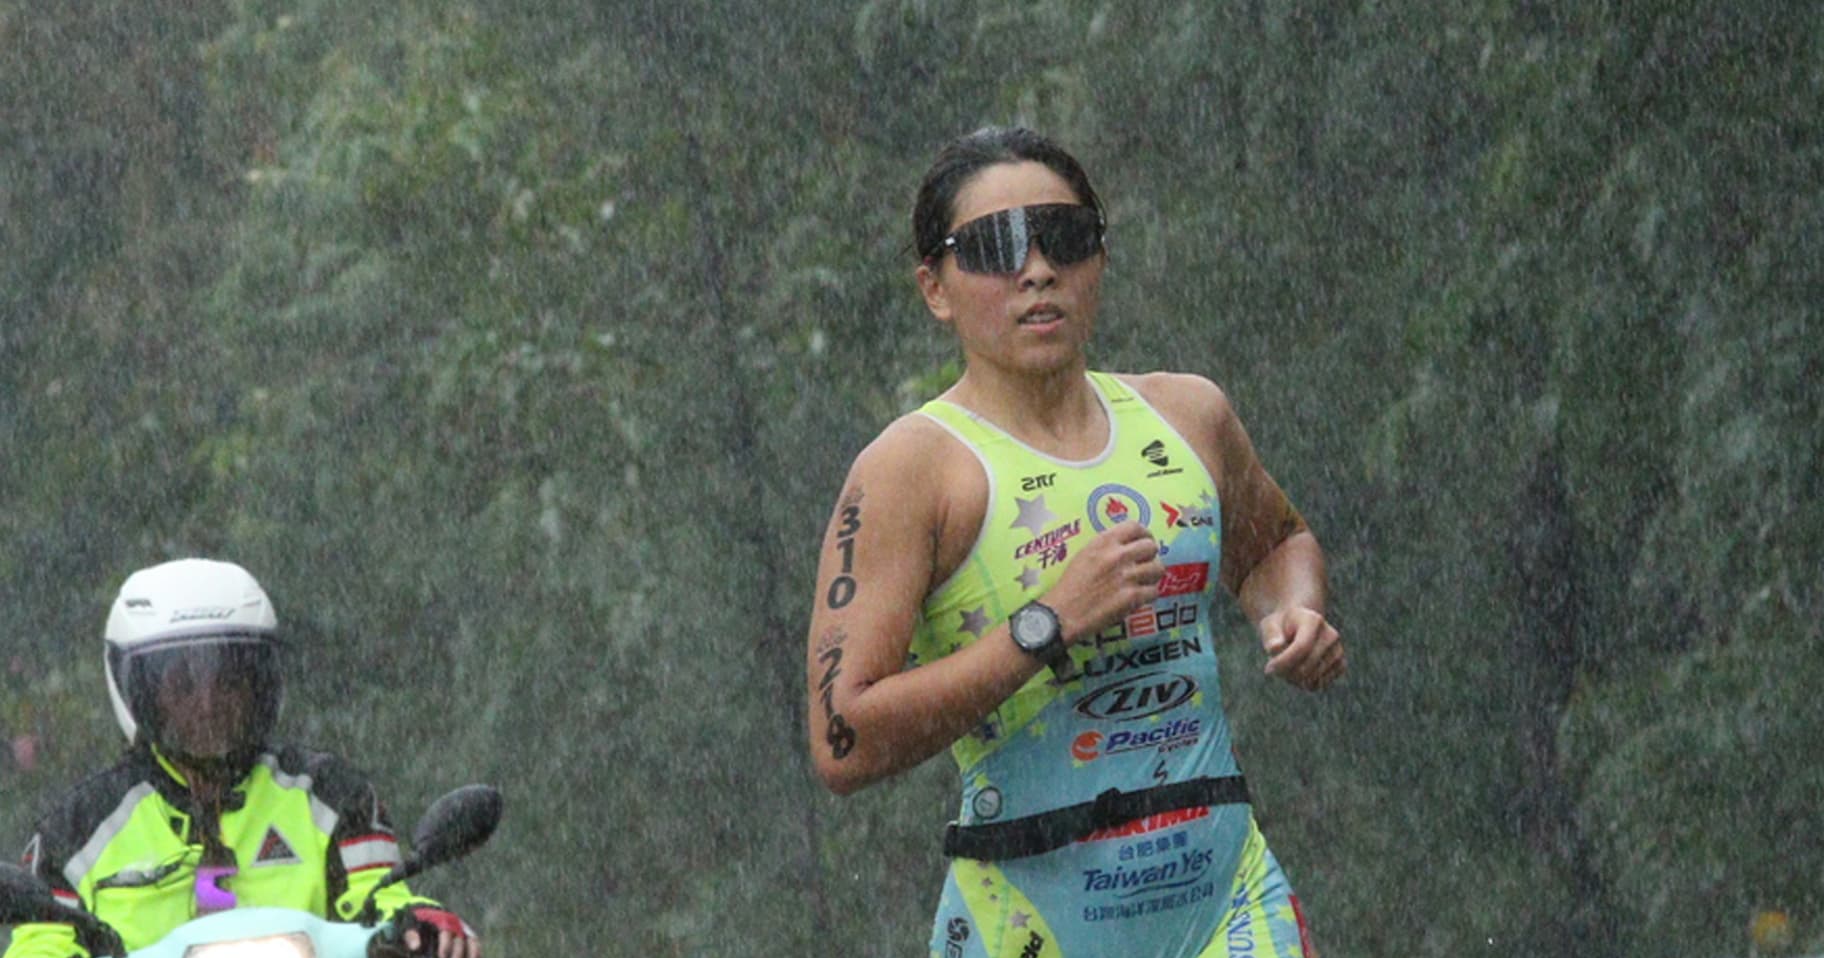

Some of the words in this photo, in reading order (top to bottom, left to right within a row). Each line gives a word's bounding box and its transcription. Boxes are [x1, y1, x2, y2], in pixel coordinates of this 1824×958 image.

[1014, 517, 1081, 560] CENTUPLE
[827, 505, 861, 610] 310
[1104, 679, 1180, 716] ZIV
[1106, 718, 1200, 752] Pacific
[1083, 860, 1178, 893] Taiwan
